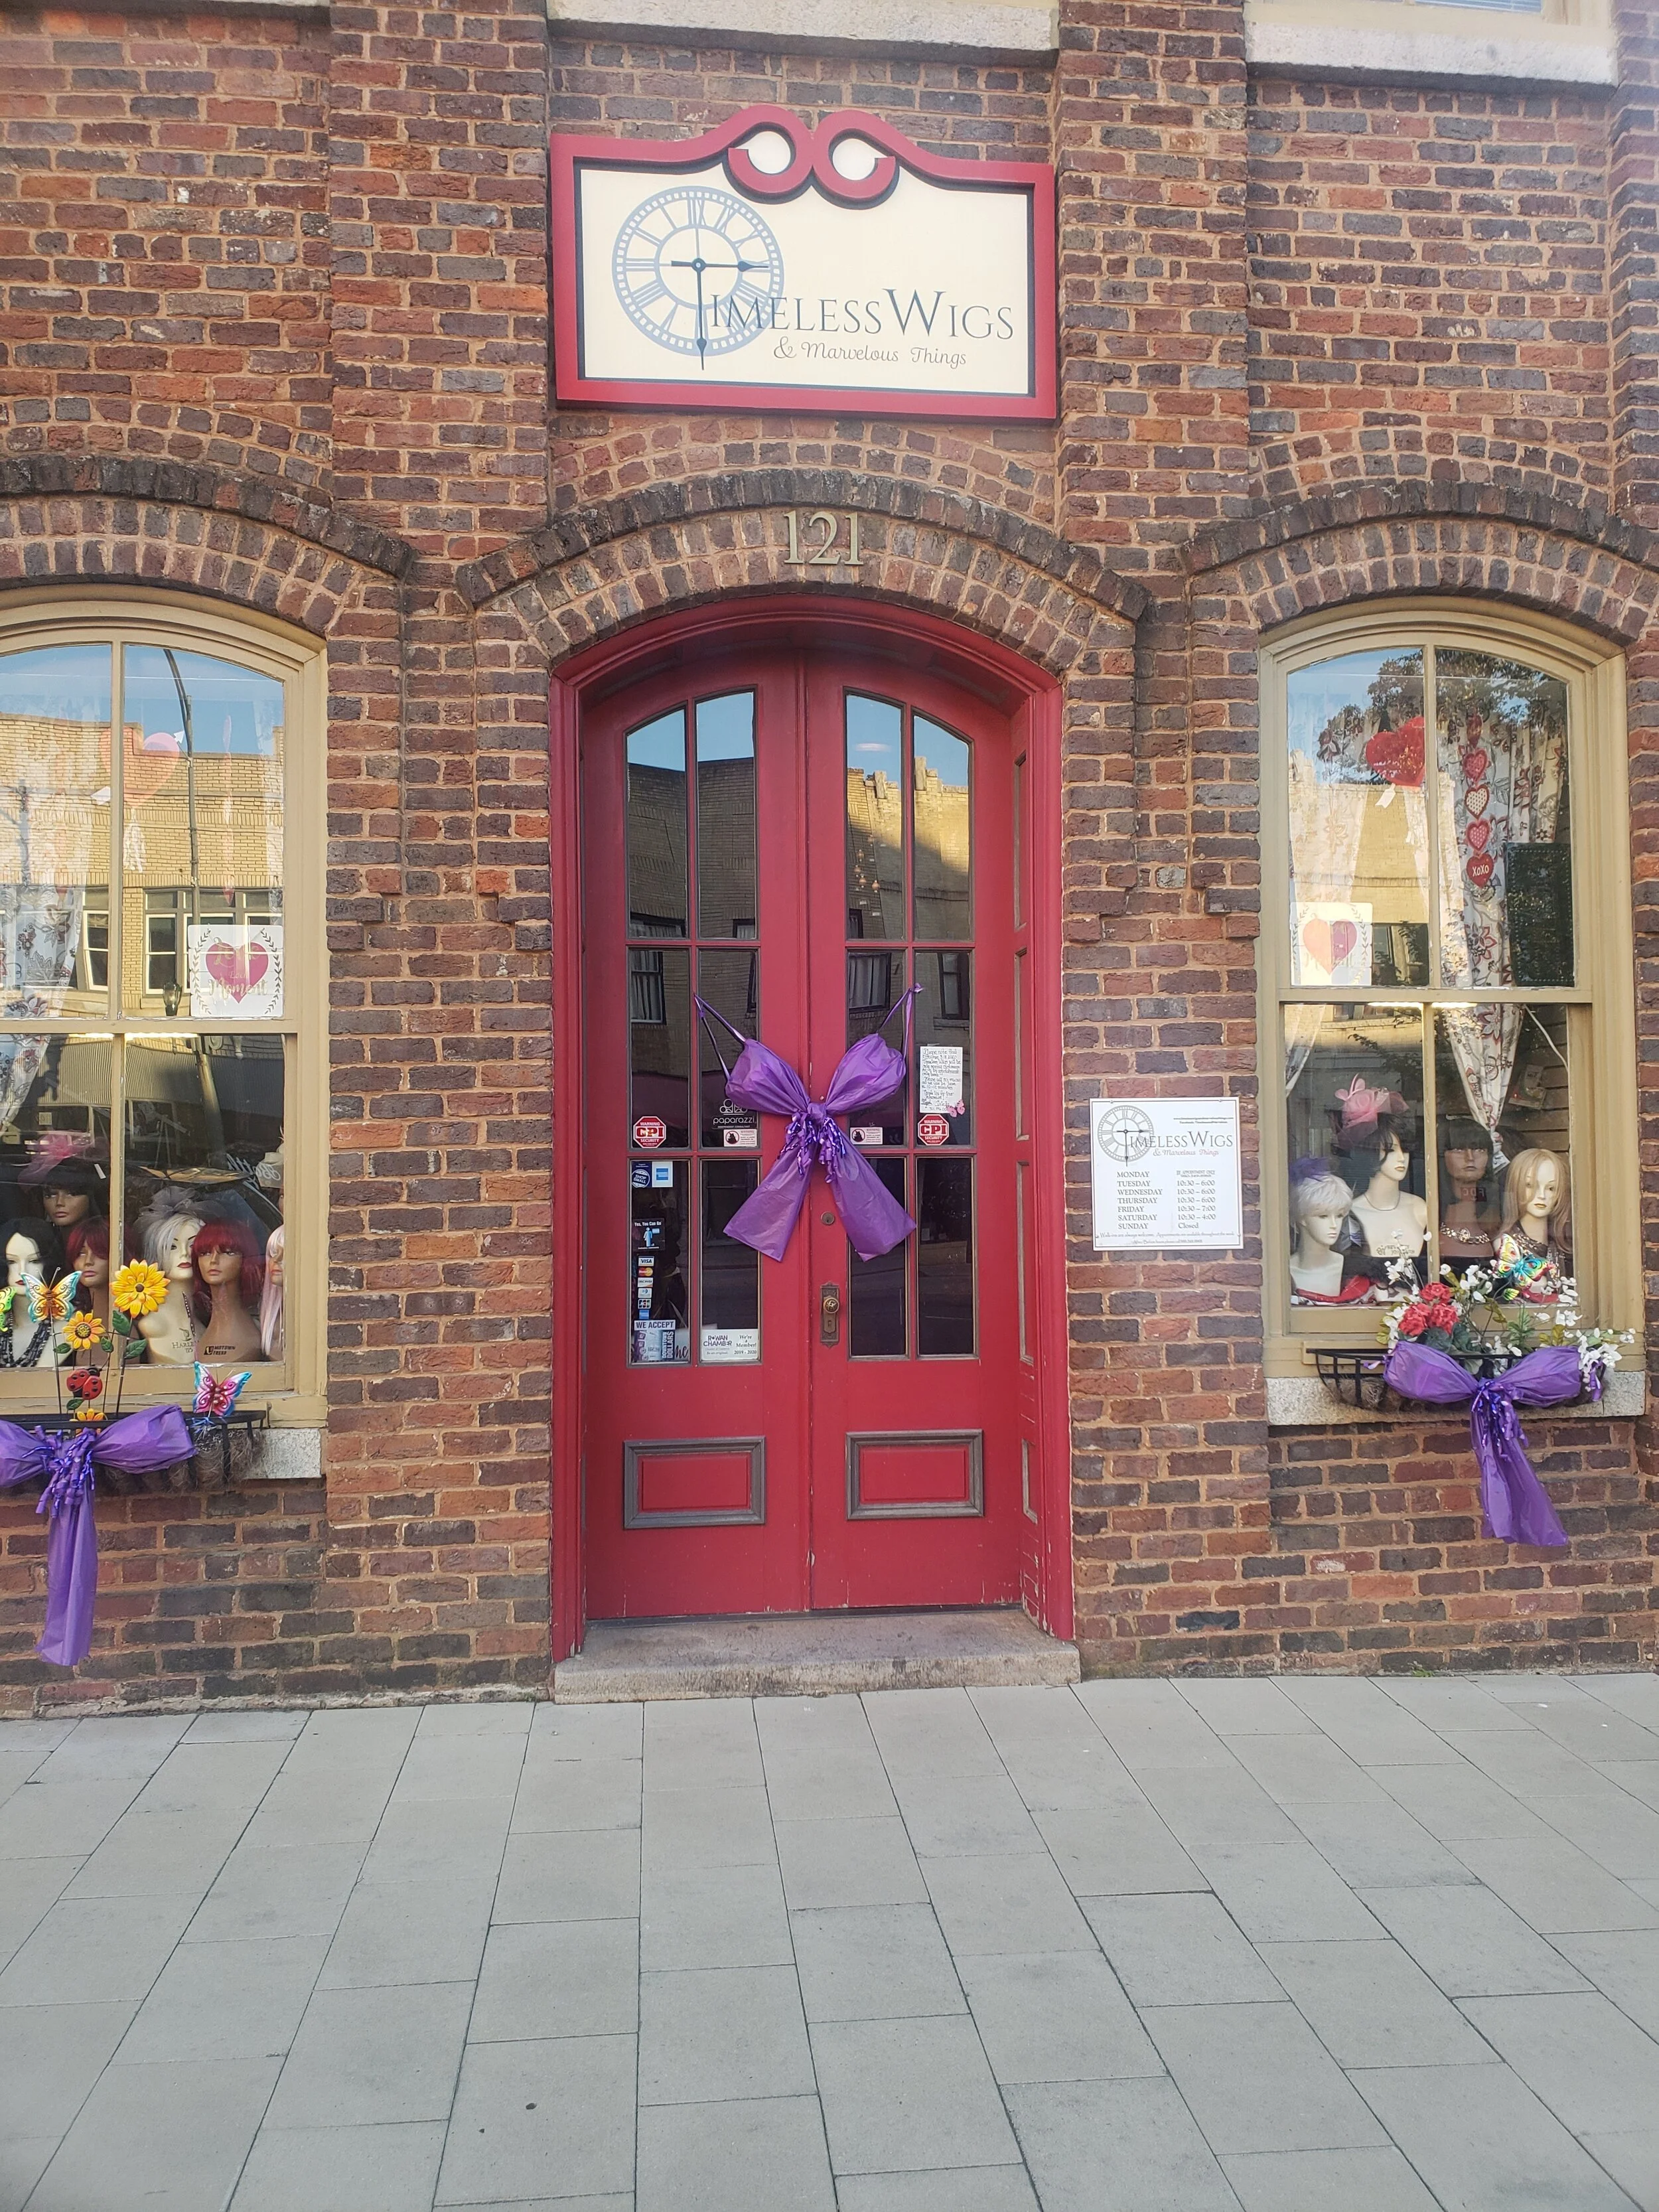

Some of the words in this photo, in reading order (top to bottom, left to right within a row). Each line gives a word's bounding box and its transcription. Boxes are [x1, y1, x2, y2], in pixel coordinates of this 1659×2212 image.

[882, 288, 1013, 340] WIGS
[774, 336, 797, 359] &
[801, 341, 899, 362] Marvelous
[910, 347, 966, 369] Things
[783, 510, 864, 565] 121
[713, 1116, 755, 1125] paparazzi
[920, 1124, 947, 1135] CPI
[1187, 1130, 1233, 1147] WIGS
